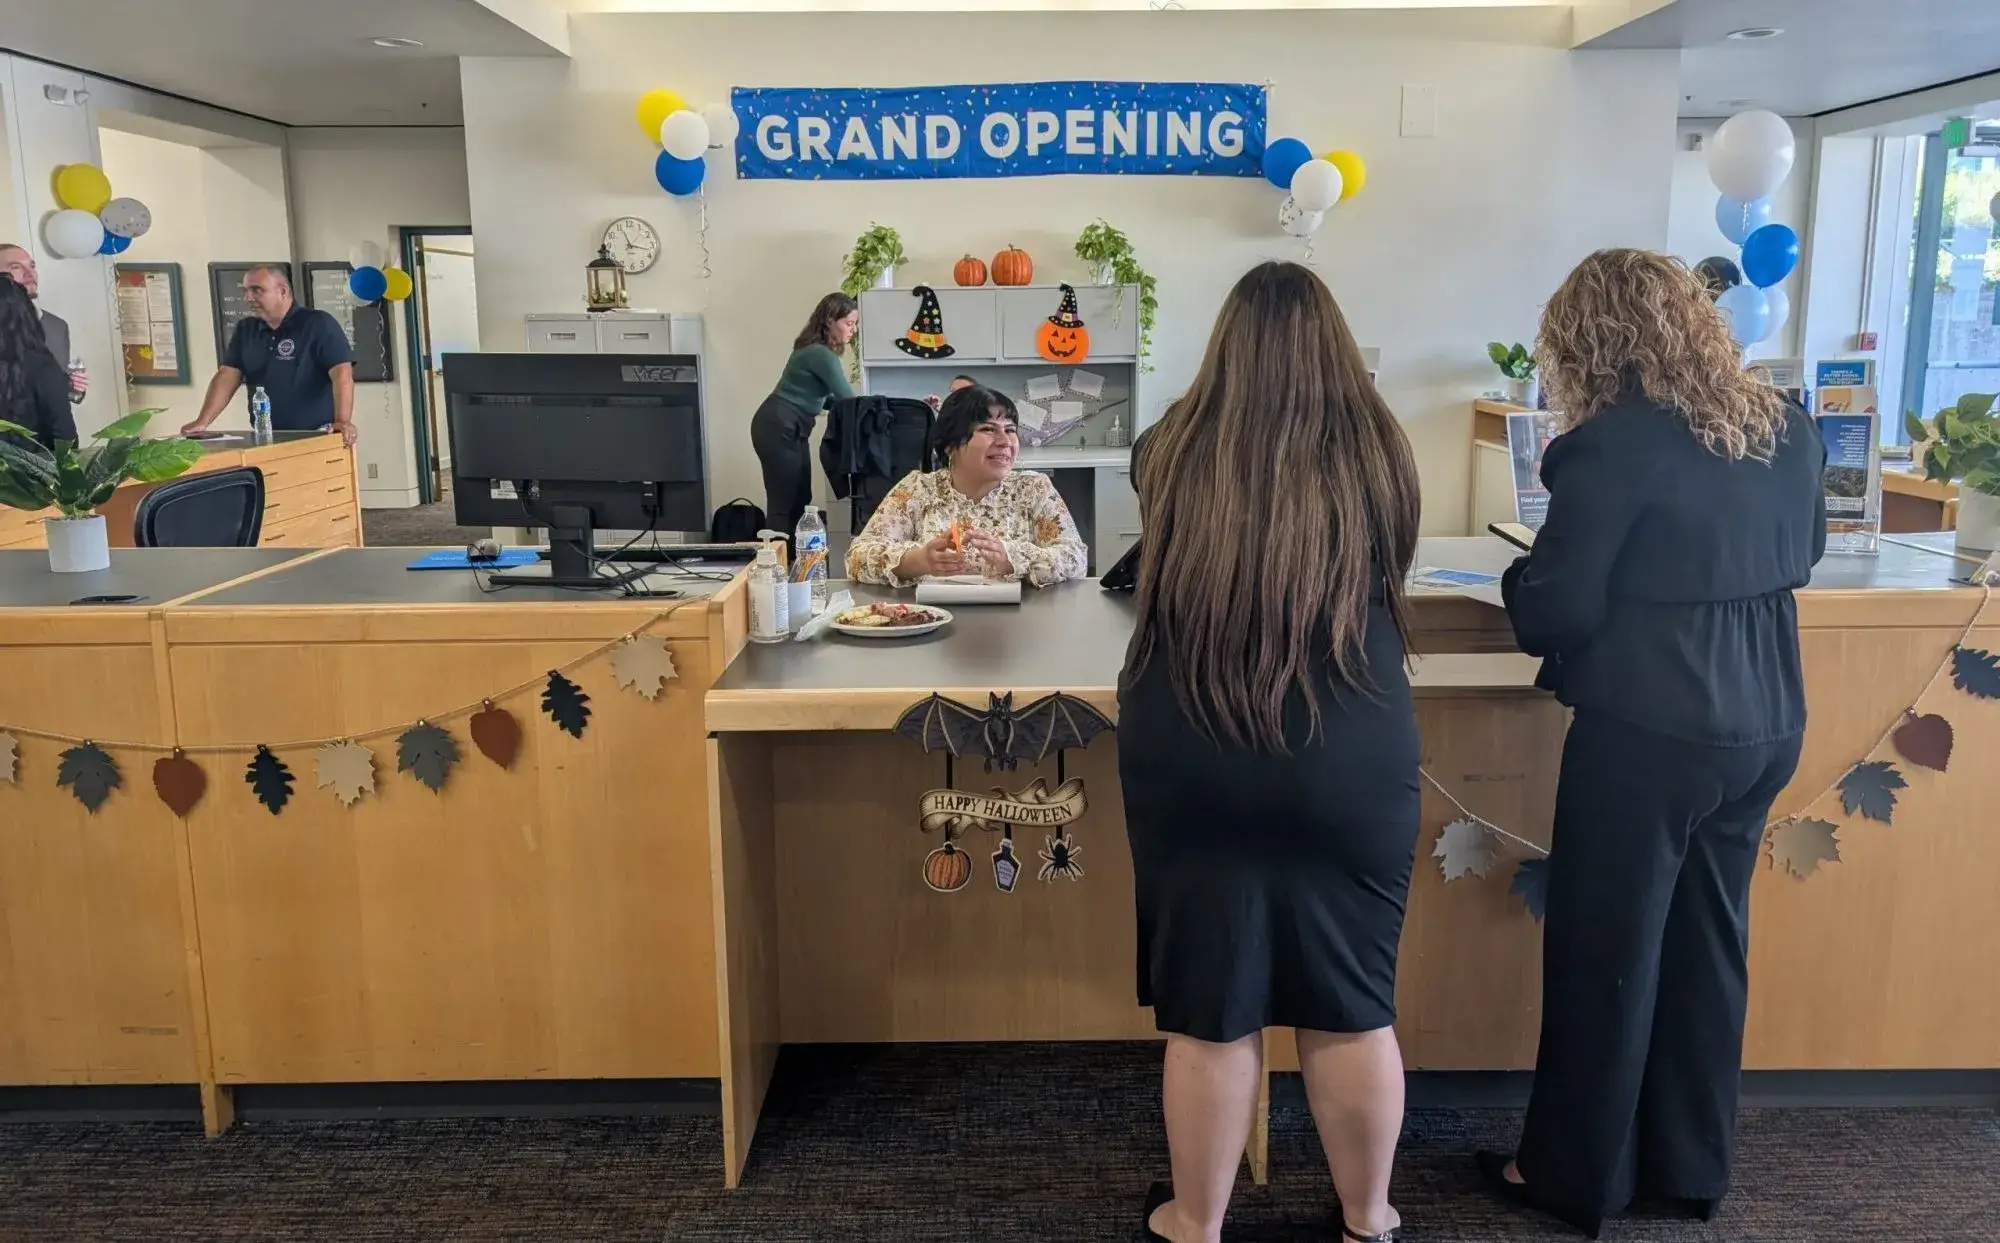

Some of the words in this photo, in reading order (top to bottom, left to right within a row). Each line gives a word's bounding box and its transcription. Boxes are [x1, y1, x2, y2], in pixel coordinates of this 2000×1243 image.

[756, 114, 961, 161] GRAND
[979, 110, 1244, 158] OPENING
[934, 795, 981, 812] HAPPY
[983, 799, 1073, 824] HALLOWEEN
